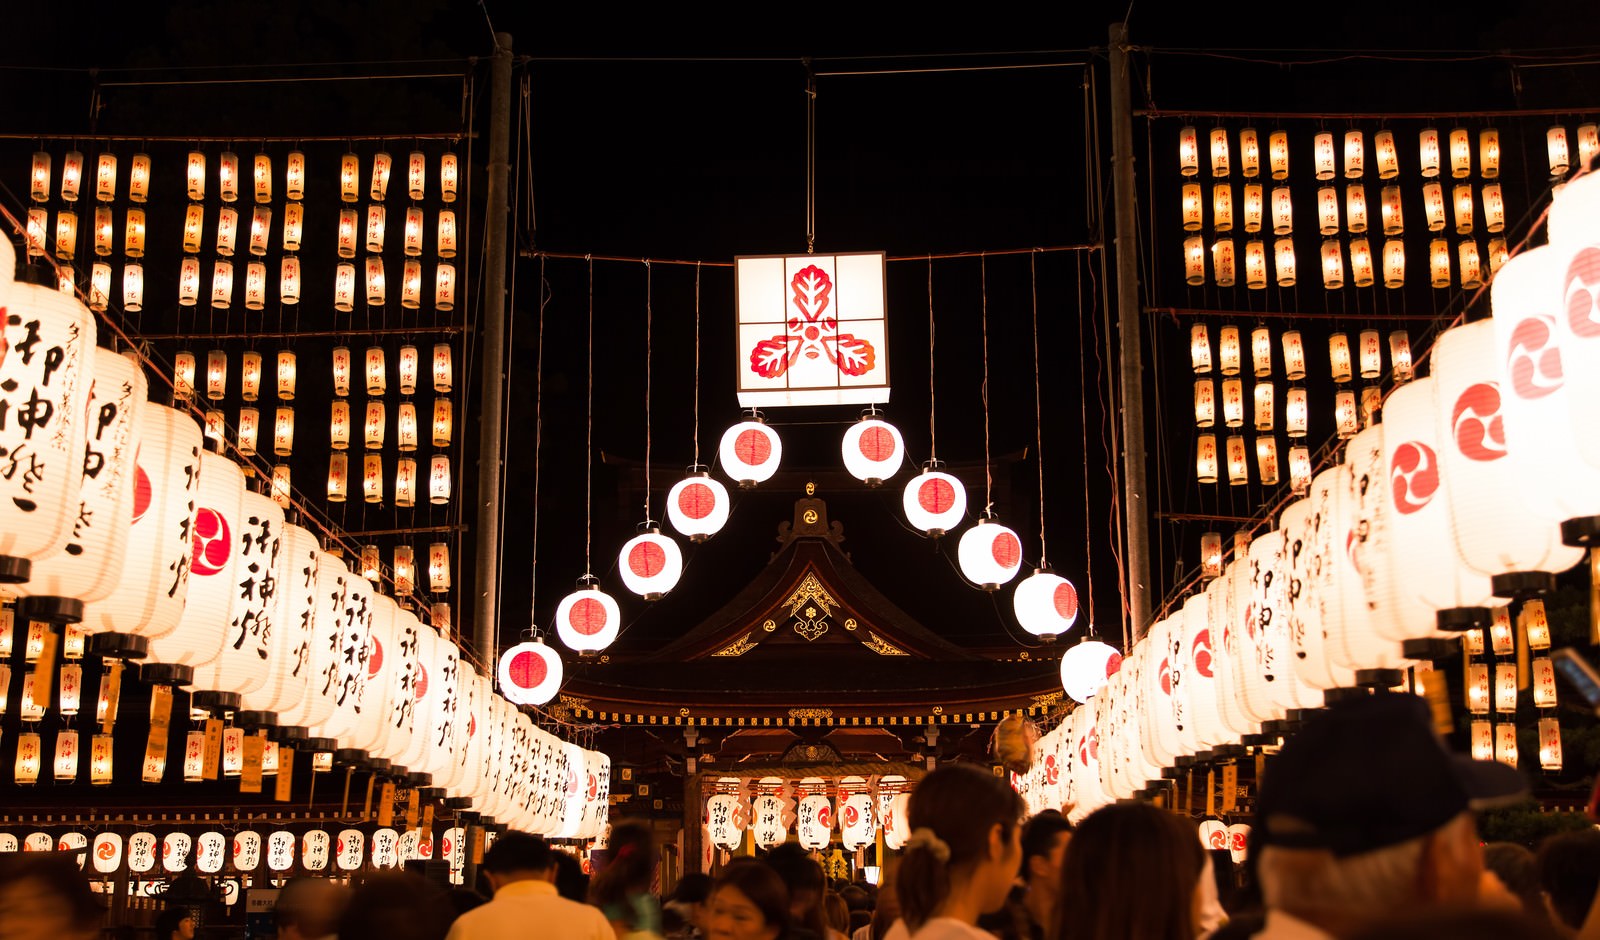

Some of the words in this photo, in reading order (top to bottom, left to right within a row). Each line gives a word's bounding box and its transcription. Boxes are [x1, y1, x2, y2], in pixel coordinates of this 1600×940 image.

[34, 160, 44, 188] 御燈
[64, 160, 77, 187] 御燈
[232, 516, 280, 660] 御神燈
[337, 593, 372, 713] 御神燈
[713, 802, 727, 838] 御神燈
[763, 799, 775, 841] 御神燈
